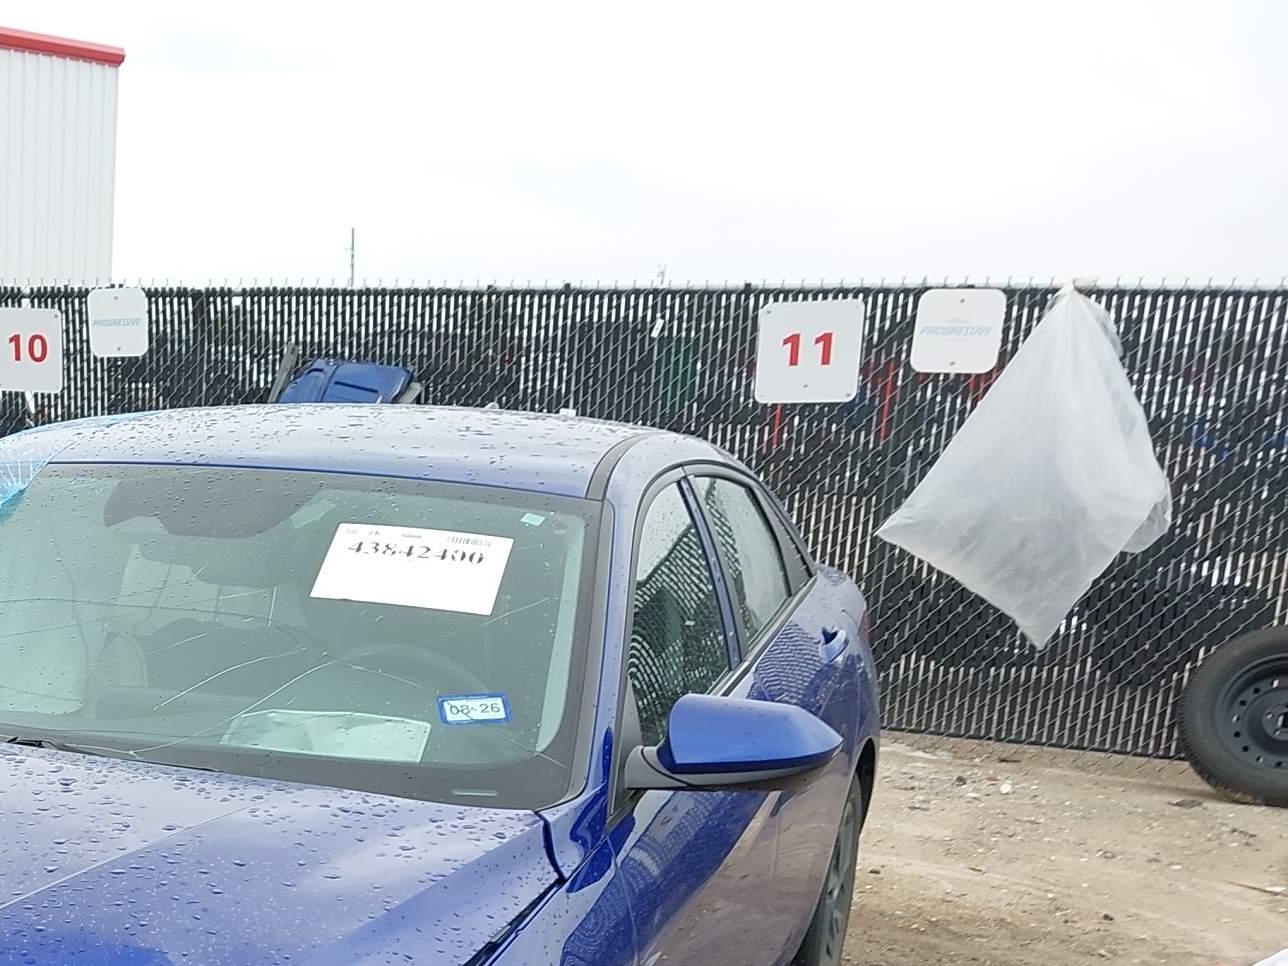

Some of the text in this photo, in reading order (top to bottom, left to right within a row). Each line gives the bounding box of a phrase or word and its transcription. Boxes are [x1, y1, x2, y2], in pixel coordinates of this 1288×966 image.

[8, 333, 49, 363] 10
[782, 331, 834, 367] 11
[348, 540, 484, 564] 43842400
